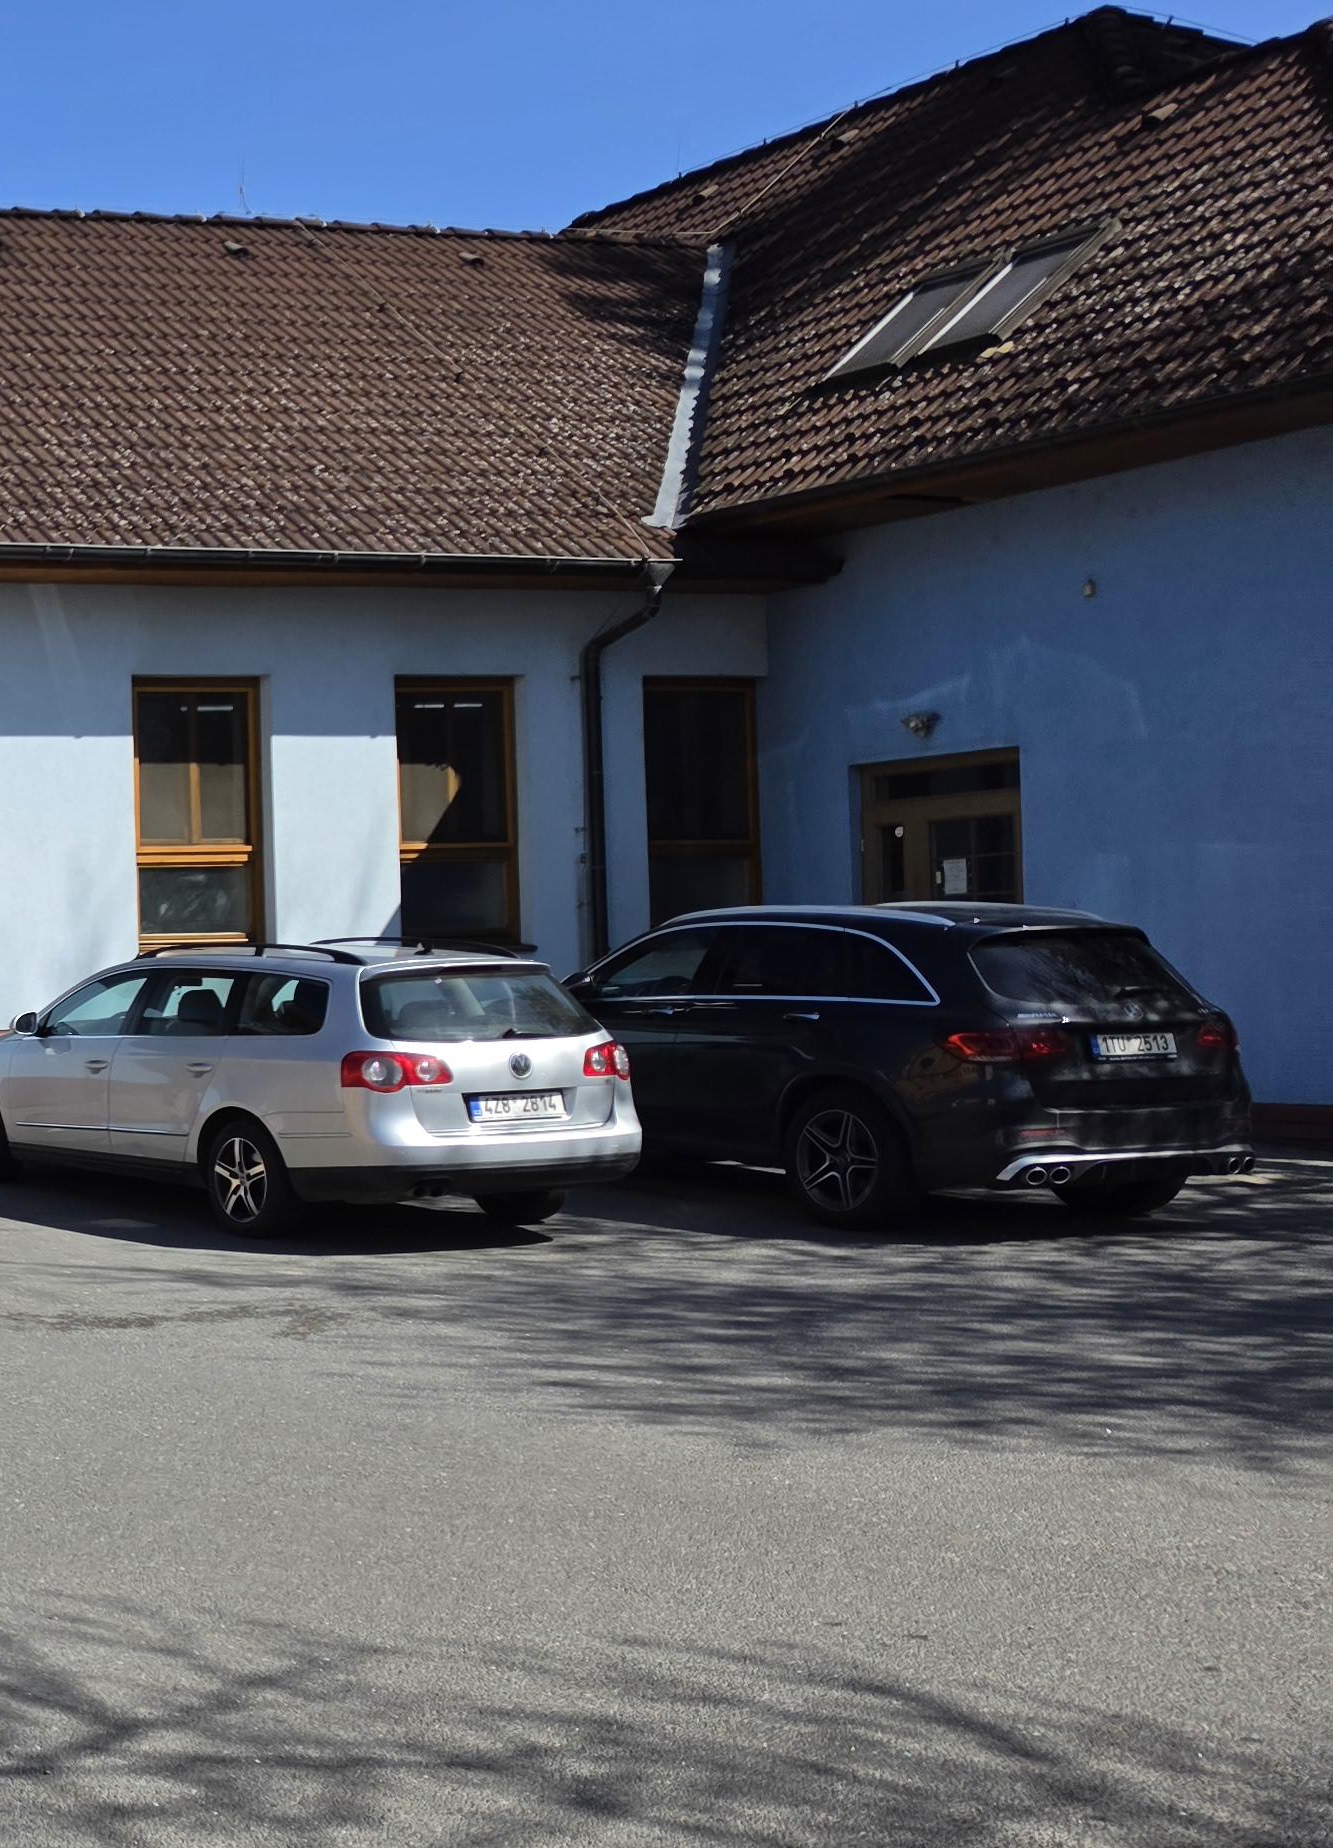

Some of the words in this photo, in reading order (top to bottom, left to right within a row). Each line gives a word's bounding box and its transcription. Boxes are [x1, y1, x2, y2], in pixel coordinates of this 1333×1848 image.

[1102, 1035, 1126, 1053] 1TU
[1135, 1033, 1169, 1052] 2513
[484, 1096, 511, 1115] 4Z8
[522, 1094, 557, 1113] 2814
